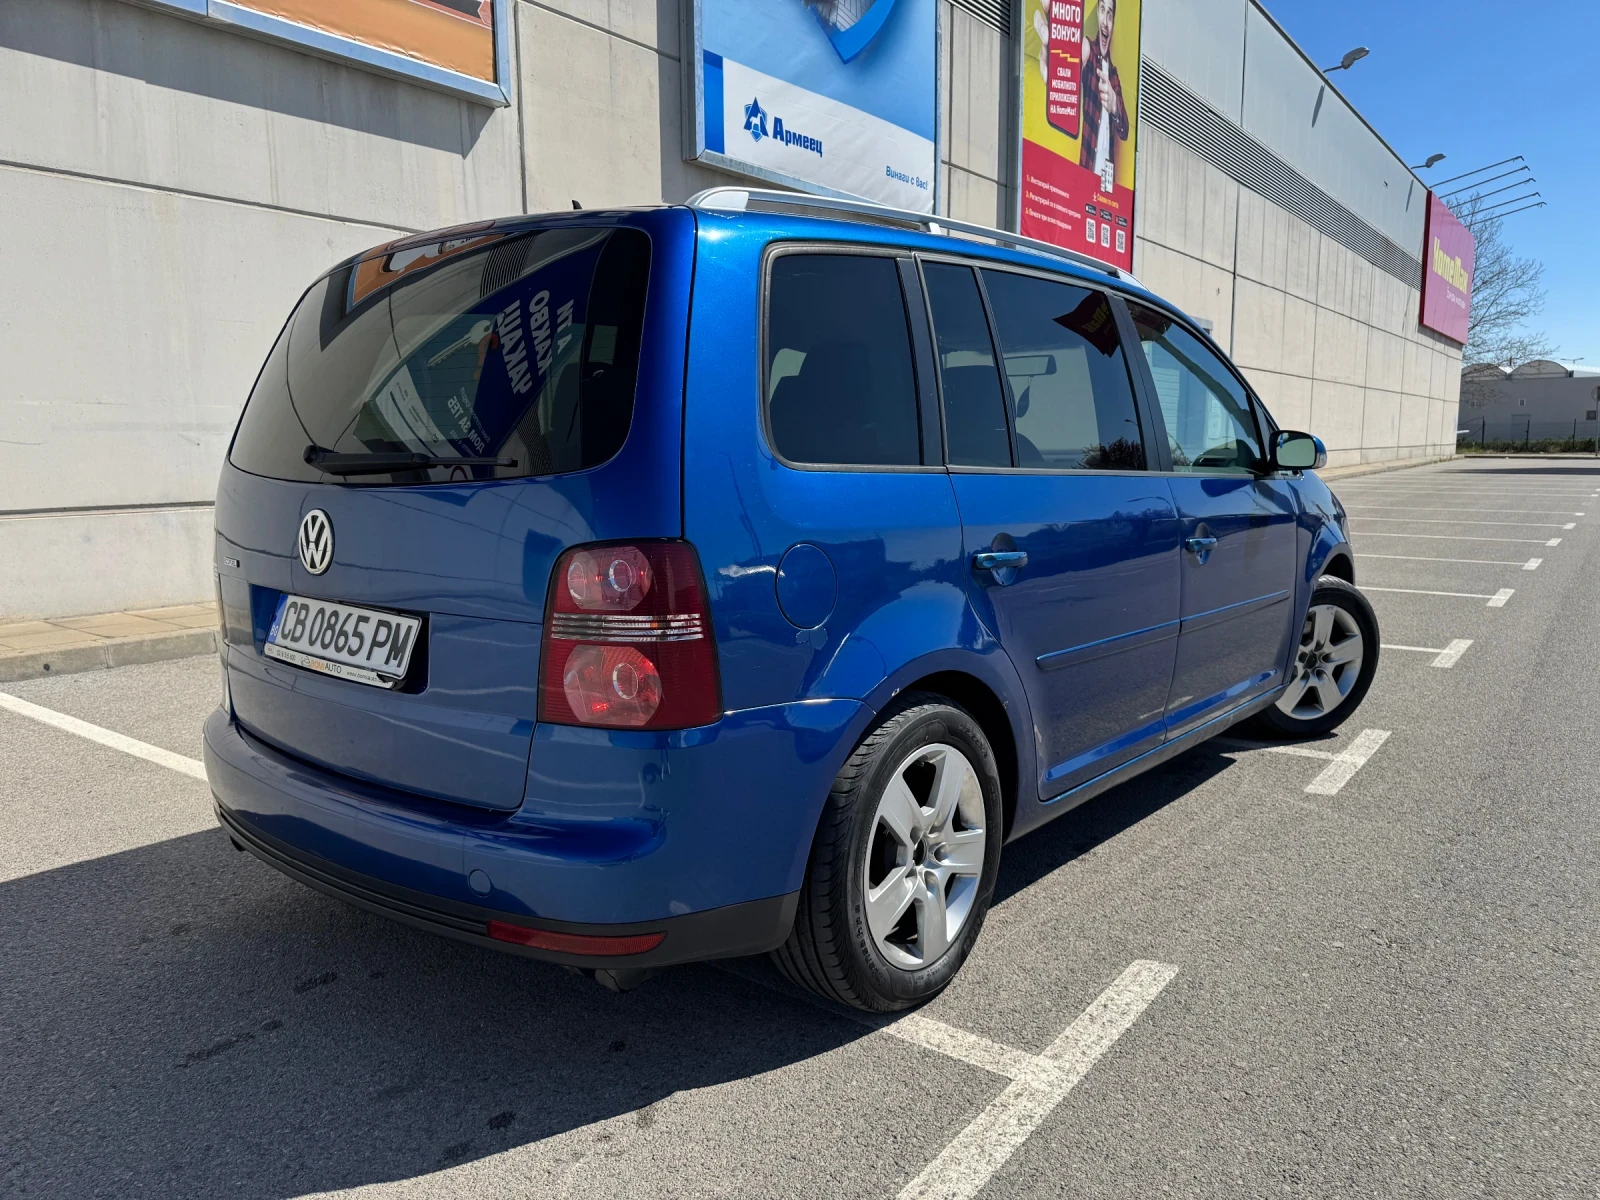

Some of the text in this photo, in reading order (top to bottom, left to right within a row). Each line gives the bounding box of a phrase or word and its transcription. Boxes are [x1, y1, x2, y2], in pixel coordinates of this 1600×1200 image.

[1052, 1, 1080, 23] МНОГО
[1051, 23, 1080, 43] БОНУСИ
[772, 116, 823, 157] Армеец
[886, 165, 909, 183] Винаги
[308, 607, 371, 656] 0865
